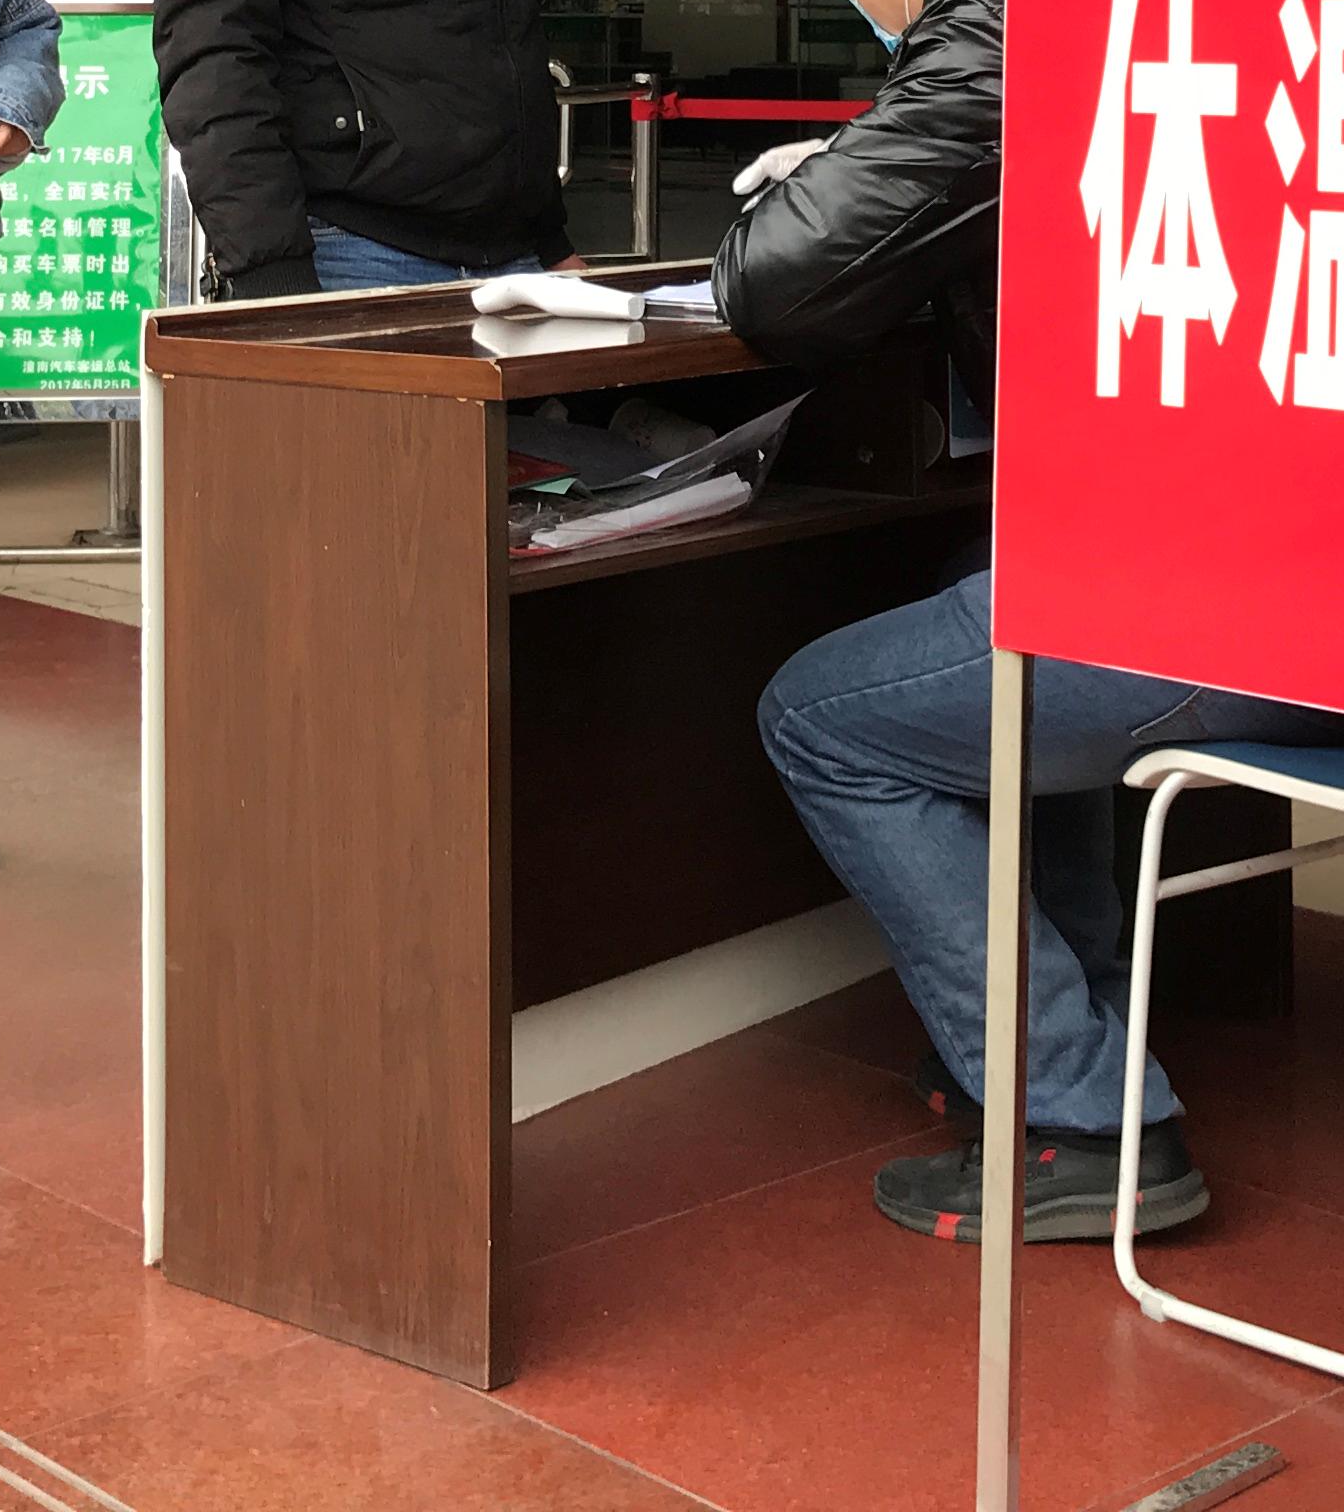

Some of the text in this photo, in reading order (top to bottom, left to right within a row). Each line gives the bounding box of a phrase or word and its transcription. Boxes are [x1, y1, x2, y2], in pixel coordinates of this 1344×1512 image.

[59, 65, 110, 100] 示
[22, 360, 131, 374] 潼南汽车客运总站
[40, 379, 131, 389] 2017年5月25日
